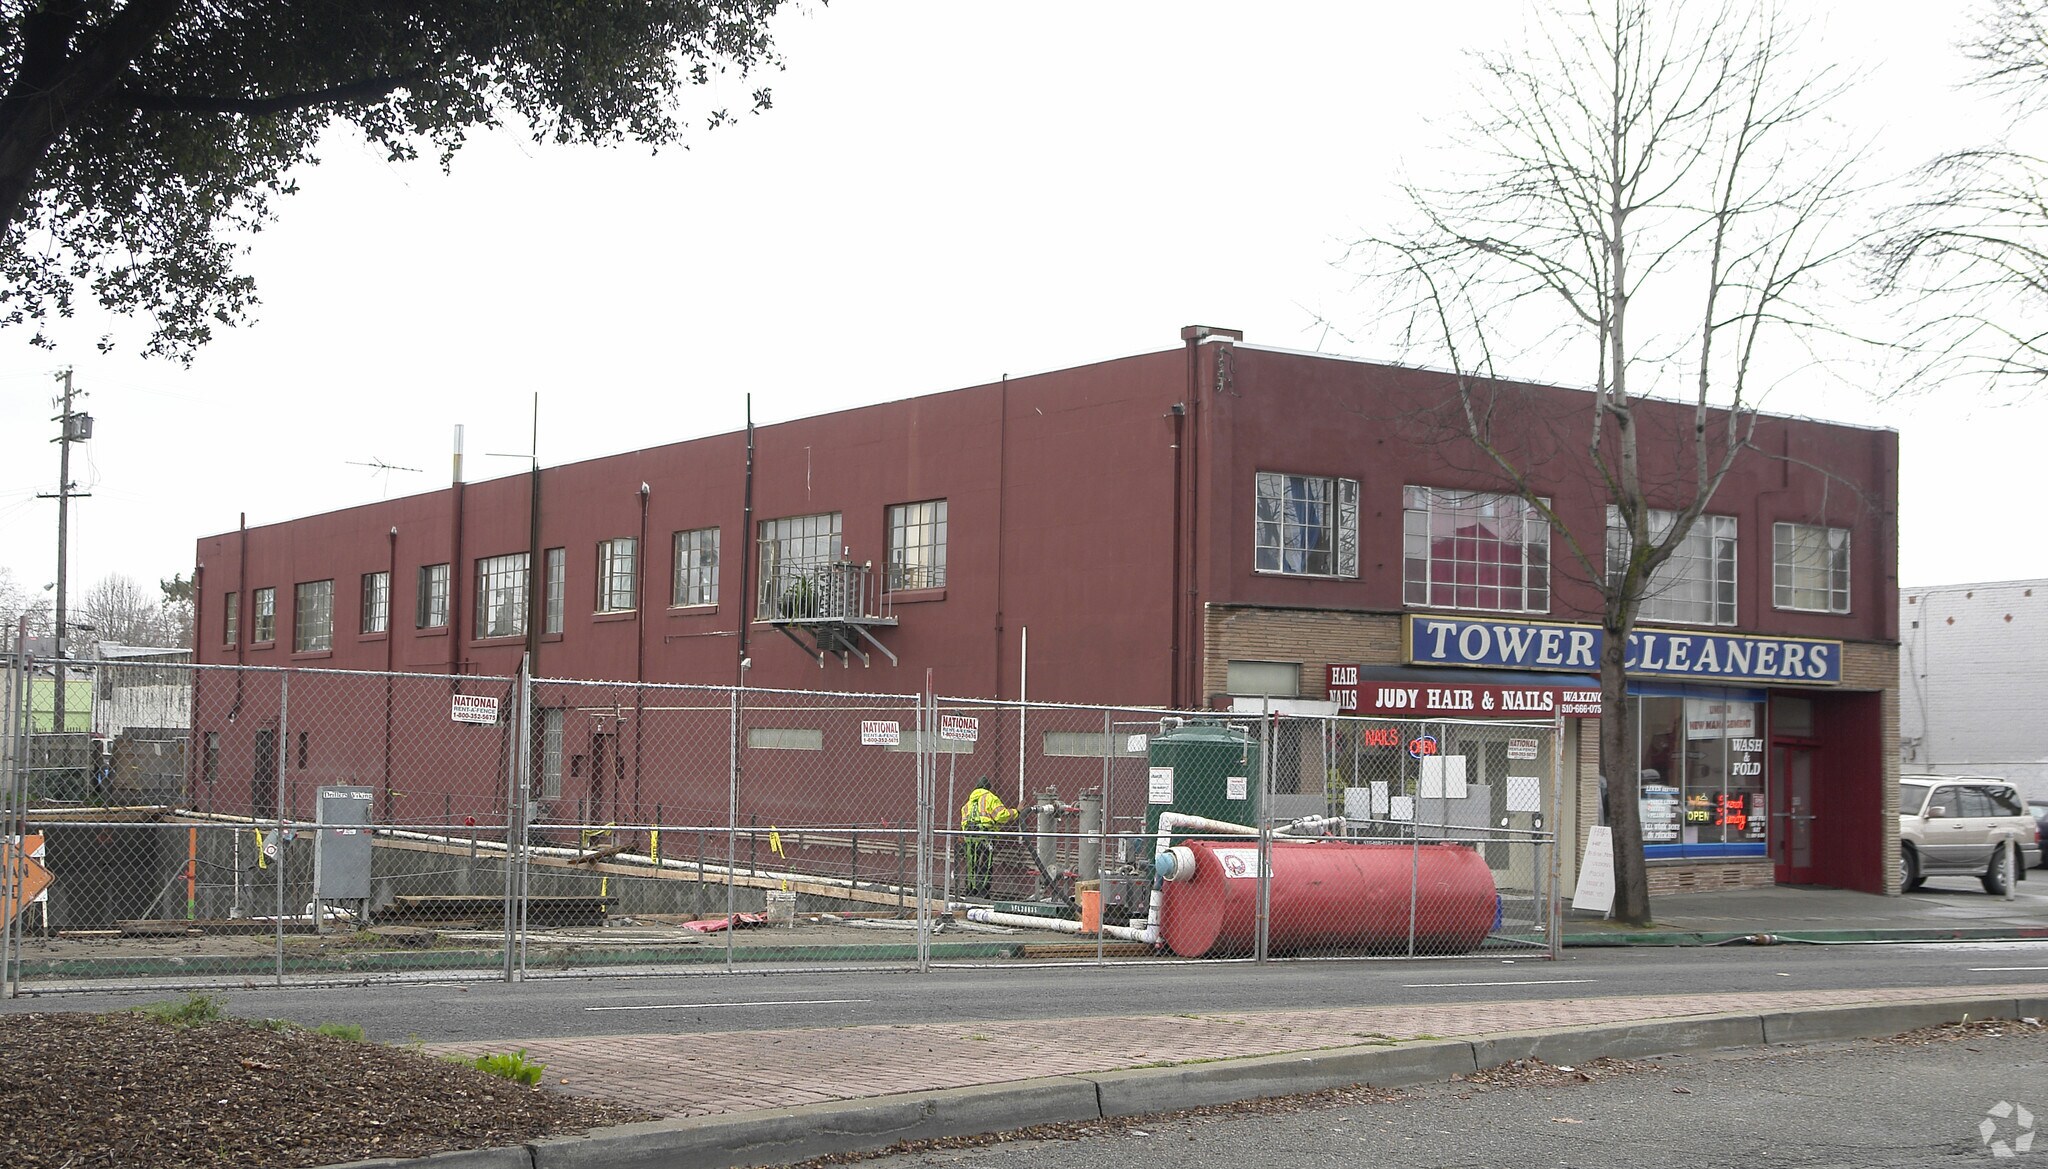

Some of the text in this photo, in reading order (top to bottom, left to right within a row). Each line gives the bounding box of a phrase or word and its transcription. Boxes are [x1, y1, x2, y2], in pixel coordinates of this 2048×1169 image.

[1427, 622, 1595, 666] TOWER
[1331, 667, 1358, 686] HAIR
[453, 696, 497, 709] NATIONAL
[1329, 689, 1357, 711] NAILS
[1376, 688, 1554, 712] JUDY HAIR & NAILS
[1561, 704, 1603, 714] 510-666-075
[1709, 705, 1732, 715] UNDR
[863, 721, 899, 733] NATIONAL
[942, 715, 977, 730] NATIONAL
[1688, 720, 1706, 730] NEW
[1365, 728, 1399, 746] NAILS
[1509, 739, 1537, 748] NATIONAL
[1409, 739, 1438, 755] OPEN
[1731, 738, 1764, 752] WASH
[1743, 752, 1751, 762] &
[1731, 763, 1762, 776] FOLD
[1687, 811, 1710, 821] OPEN
